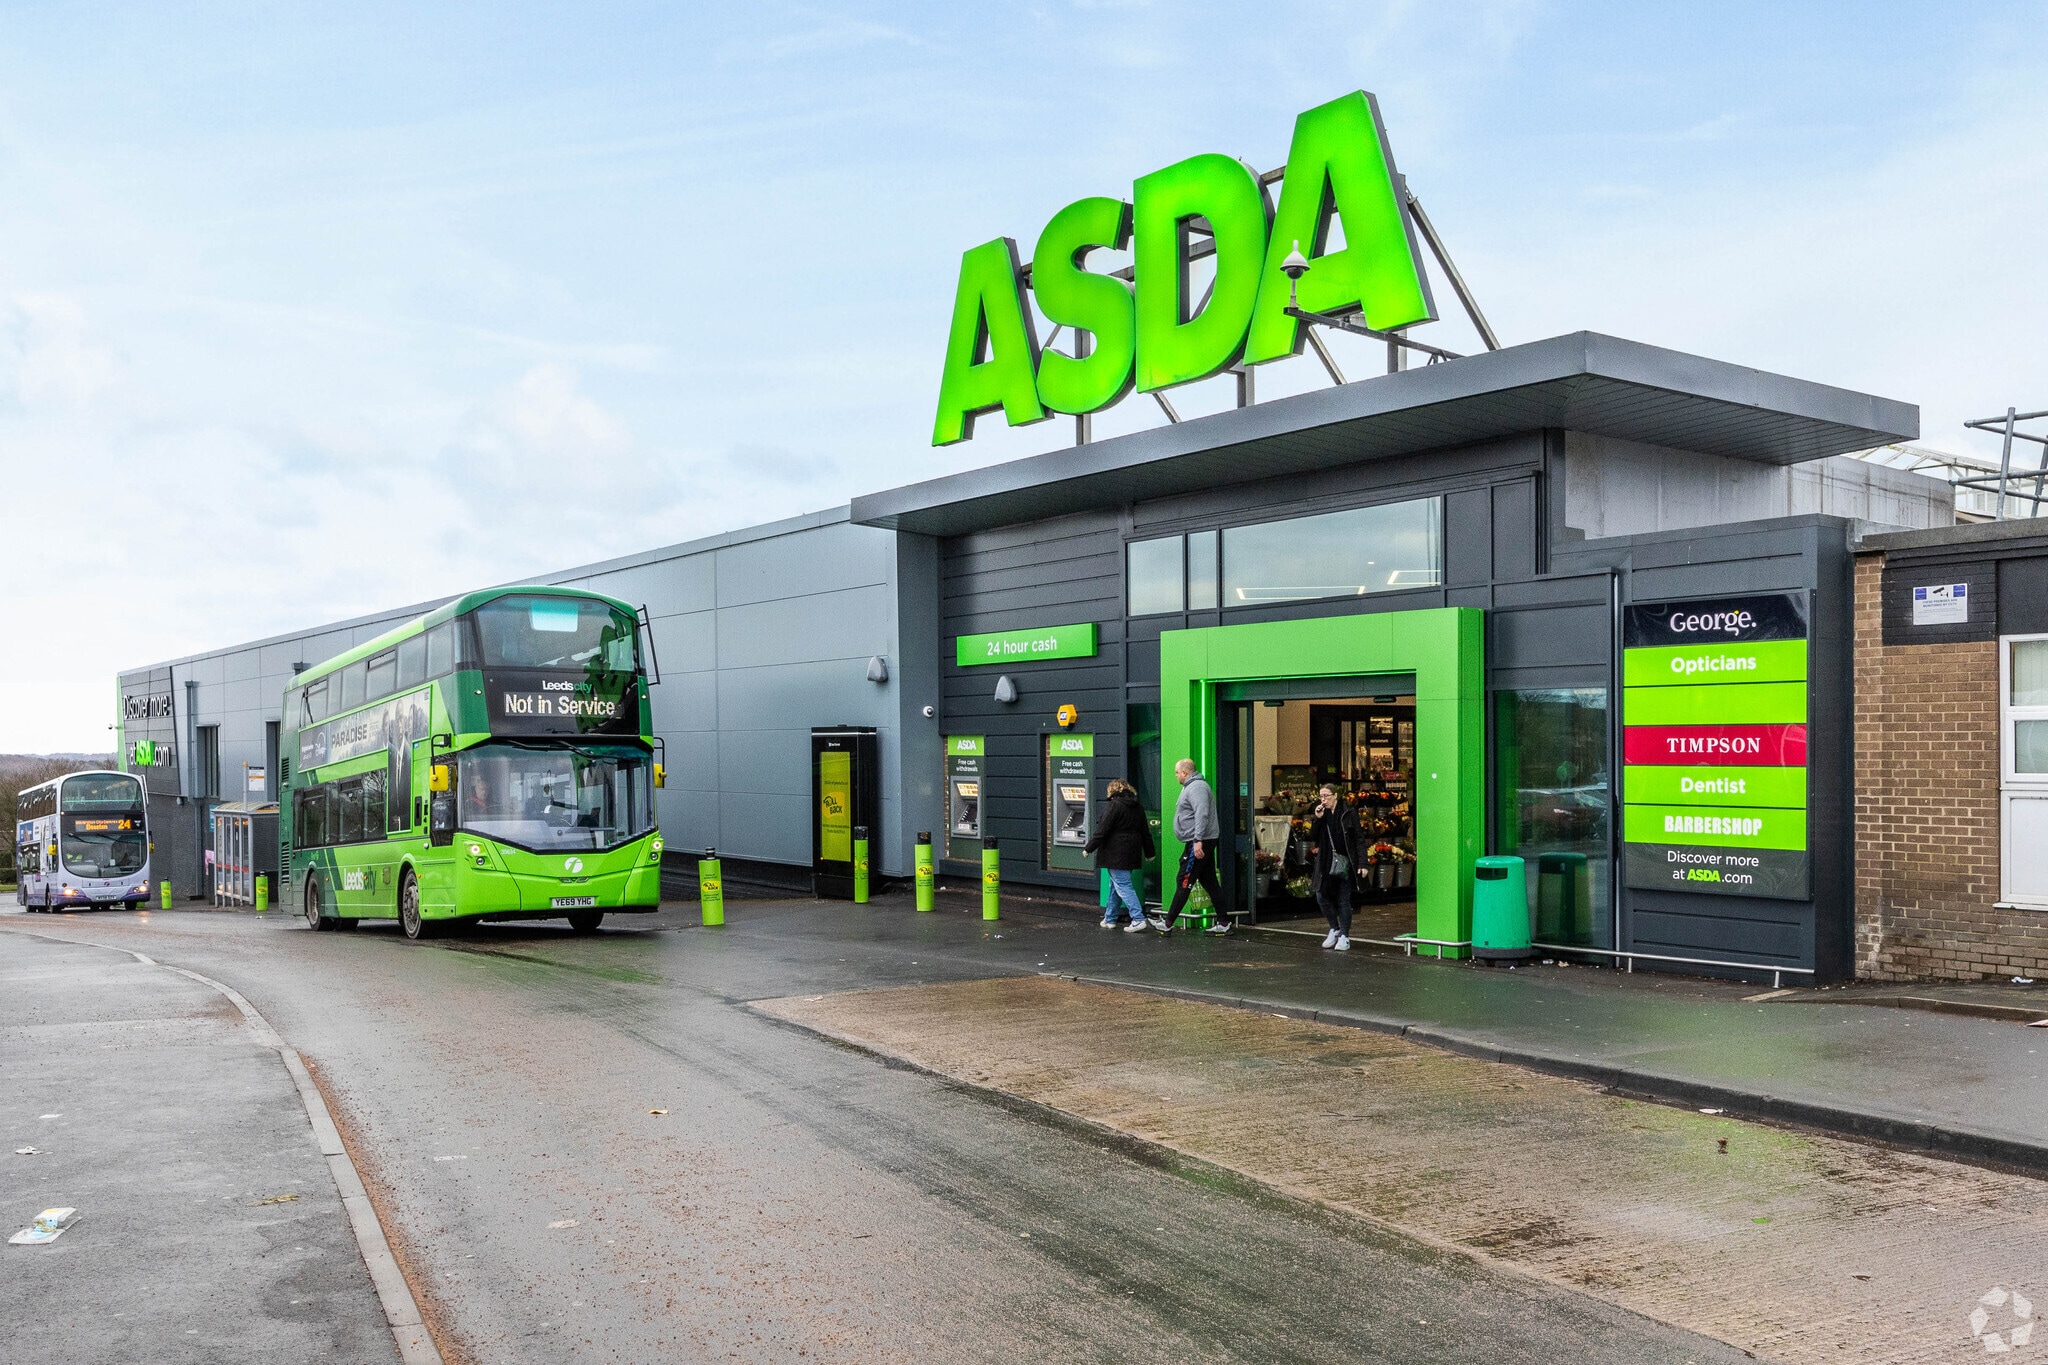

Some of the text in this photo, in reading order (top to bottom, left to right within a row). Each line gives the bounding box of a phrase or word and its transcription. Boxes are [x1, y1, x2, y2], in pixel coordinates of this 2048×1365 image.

[932, 90, 1438, 446] ASDA
[987, 635, 1057, 656] 24 hour cash
[1671, 654, 1757, 675] Opticians
[123, 695, 168, 719] Discover more
[505, 694, 615, 716] Not in Service
[331, 723, 368, 749] PARADISE
[957, 740, 977, 750] ASDA
[1060, 739, 1084, 751] ASDA
[1667, 737, 1760, 753] TIMPSON
[1059, 767, 1086, 775] withdrawals
[1681, 777, 1746, 794] Dentist
[118, 819, 131, 830] 24
[1664, 815, 1763, 836] BARBERSHOP
[1667, 850, 1759, 867] Discover more
[1672, 868, 1685, 881] at
[555, 897, 592, 907] YE69 YHG
